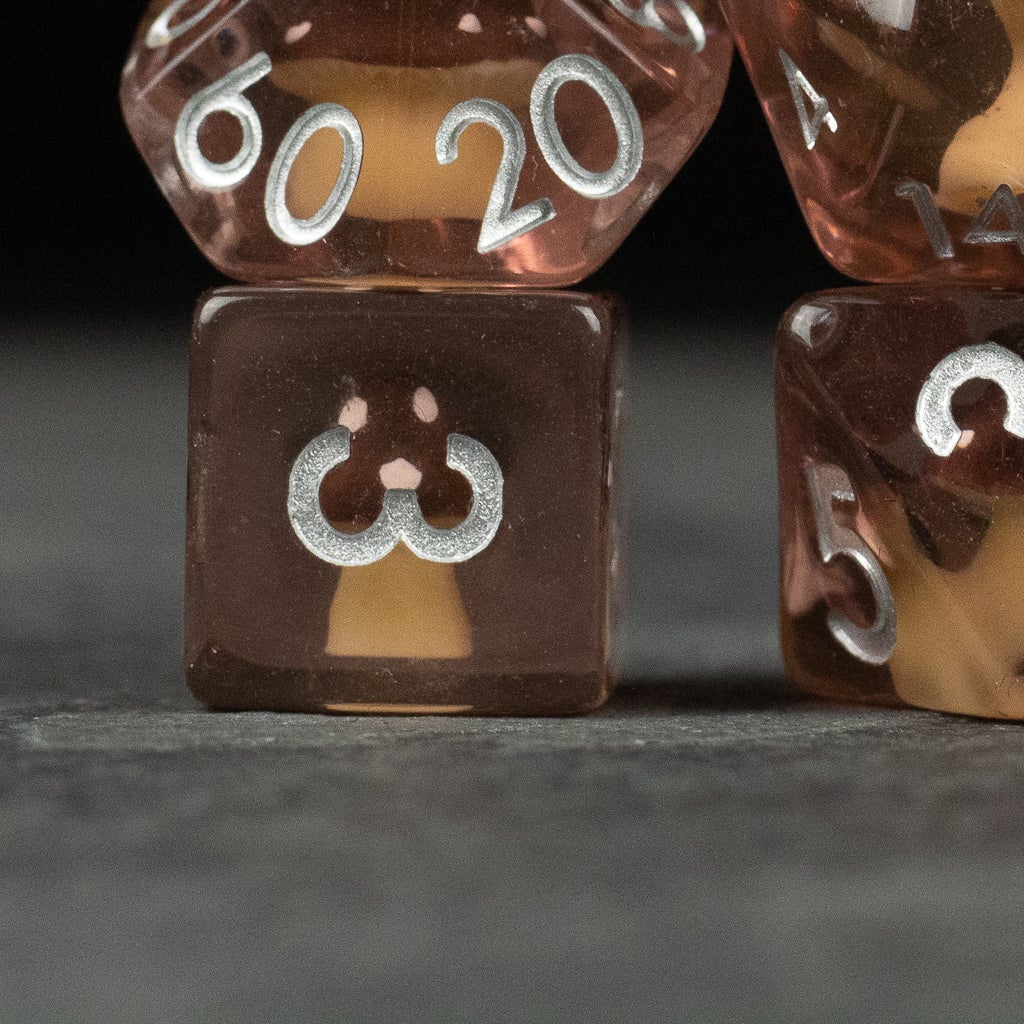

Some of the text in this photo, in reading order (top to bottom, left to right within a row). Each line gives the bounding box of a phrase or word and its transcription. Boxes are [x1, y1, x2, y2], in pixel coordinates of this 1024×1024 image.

[174, 51, 364, 246] 60
[435, 52, 644, 254] 20
[778, 48, 838, 151] 4
[287, 424, 505, 568] 3
[806, 459, 898, 666] 5
